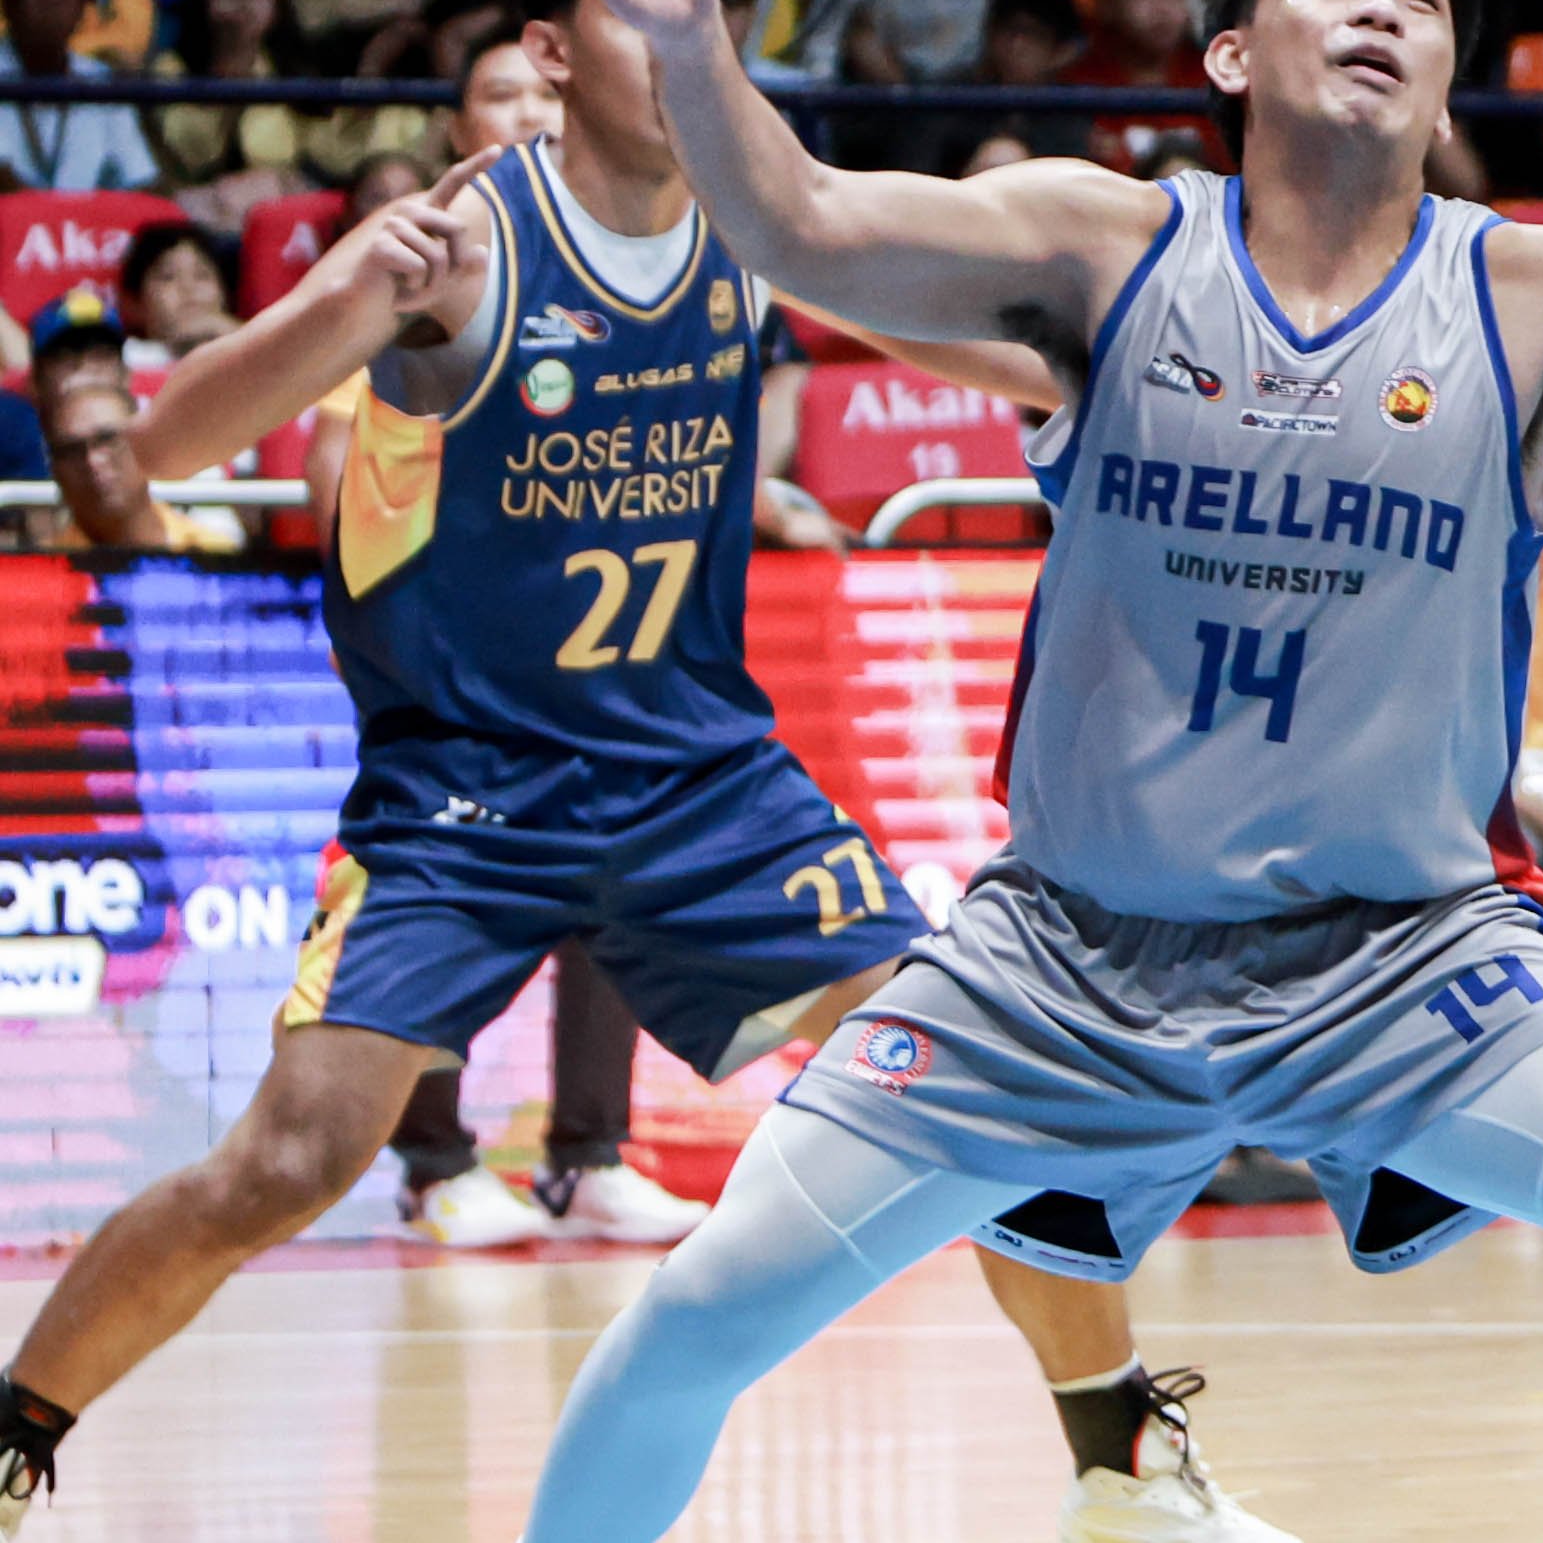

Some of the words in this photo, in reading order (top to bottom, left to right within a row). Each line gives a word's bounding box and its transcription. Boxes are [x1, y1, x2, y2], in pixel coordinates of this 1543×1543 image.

[15, 219, 132, 271] Aka
[505, 416, 633, 476] JOSÉ
[645, 413, 734, 466] RIZA
[500, 463, 726, 521] UNIVERSIT
[1097, 453, 1466, 573] ARELLANO
[556, 539, 698, 670] 27
[1165, 549, 1365, 597] UNIVERSITY
[1187, 622, 1307, 744] 14
[185, 885, 288, 949] ON
[784, 837, 888, 937] 27
